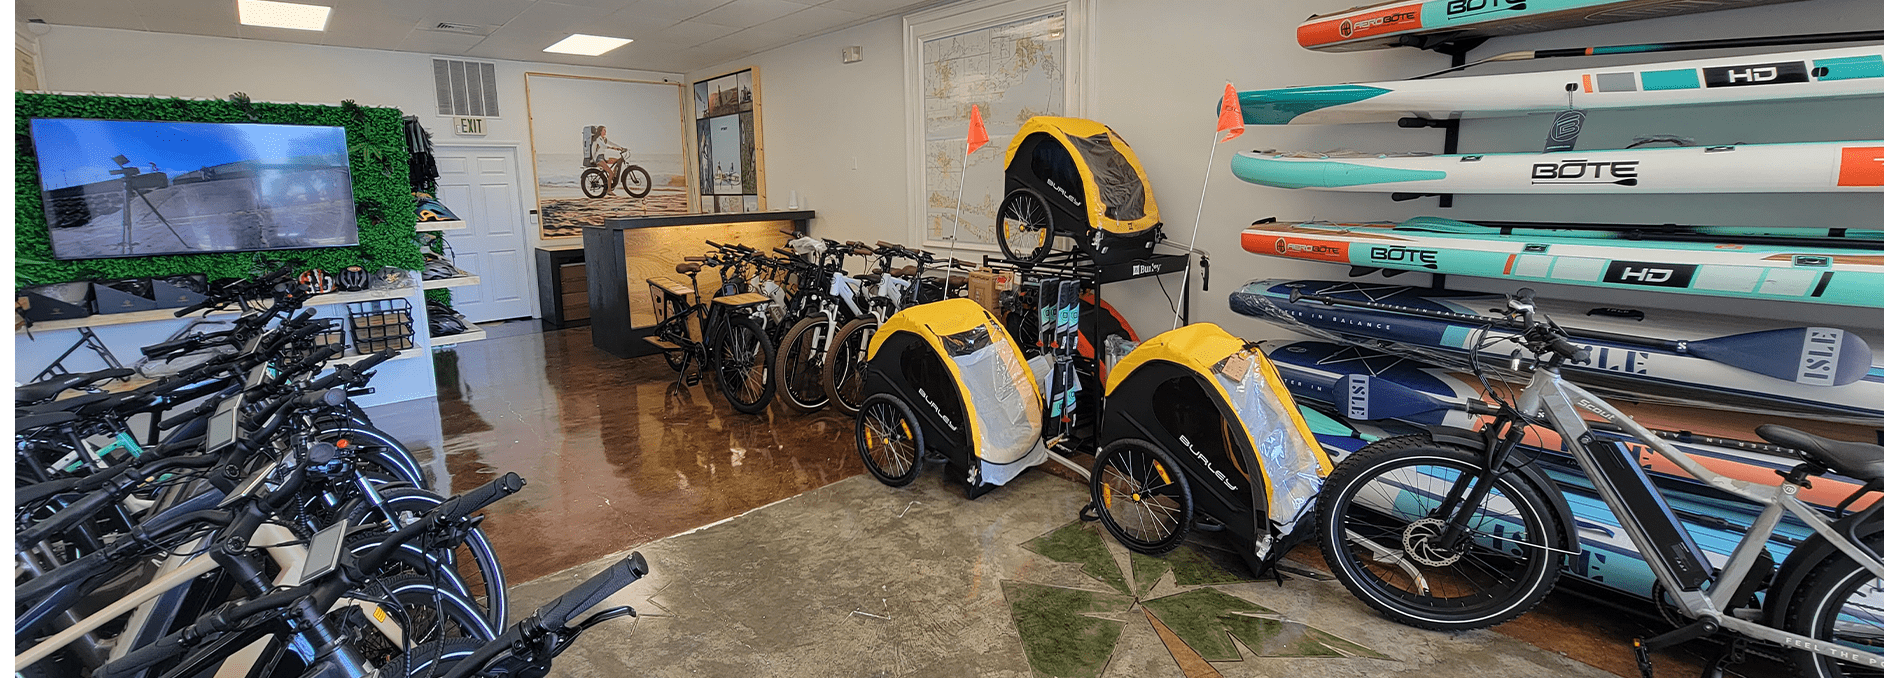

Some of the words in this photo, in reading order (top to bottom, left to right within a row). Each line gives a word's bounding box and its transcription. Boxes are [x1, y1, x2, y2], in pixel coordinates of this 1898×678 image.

[1728, 66, 1778, 83] HD
[461, 119, 481, 133] EXIT
[1046, 178, 1082, 207] BURLEY
[1620, 267, 1674, 283] HD
[1333, 316, 1390, 330] BALANCE
[1803, 331, 1837, 380] ISLE
[918, 387, 958, 431] BURLEY
[1351, 379, 1366, 416] ISLE
[1577, 398, 1616, 421] Scout
[1179, 434, 1237, 491] BURLEY
[1785, 637, 1821, 652] FEEL
[1830, 648, 1859, 661] THE
